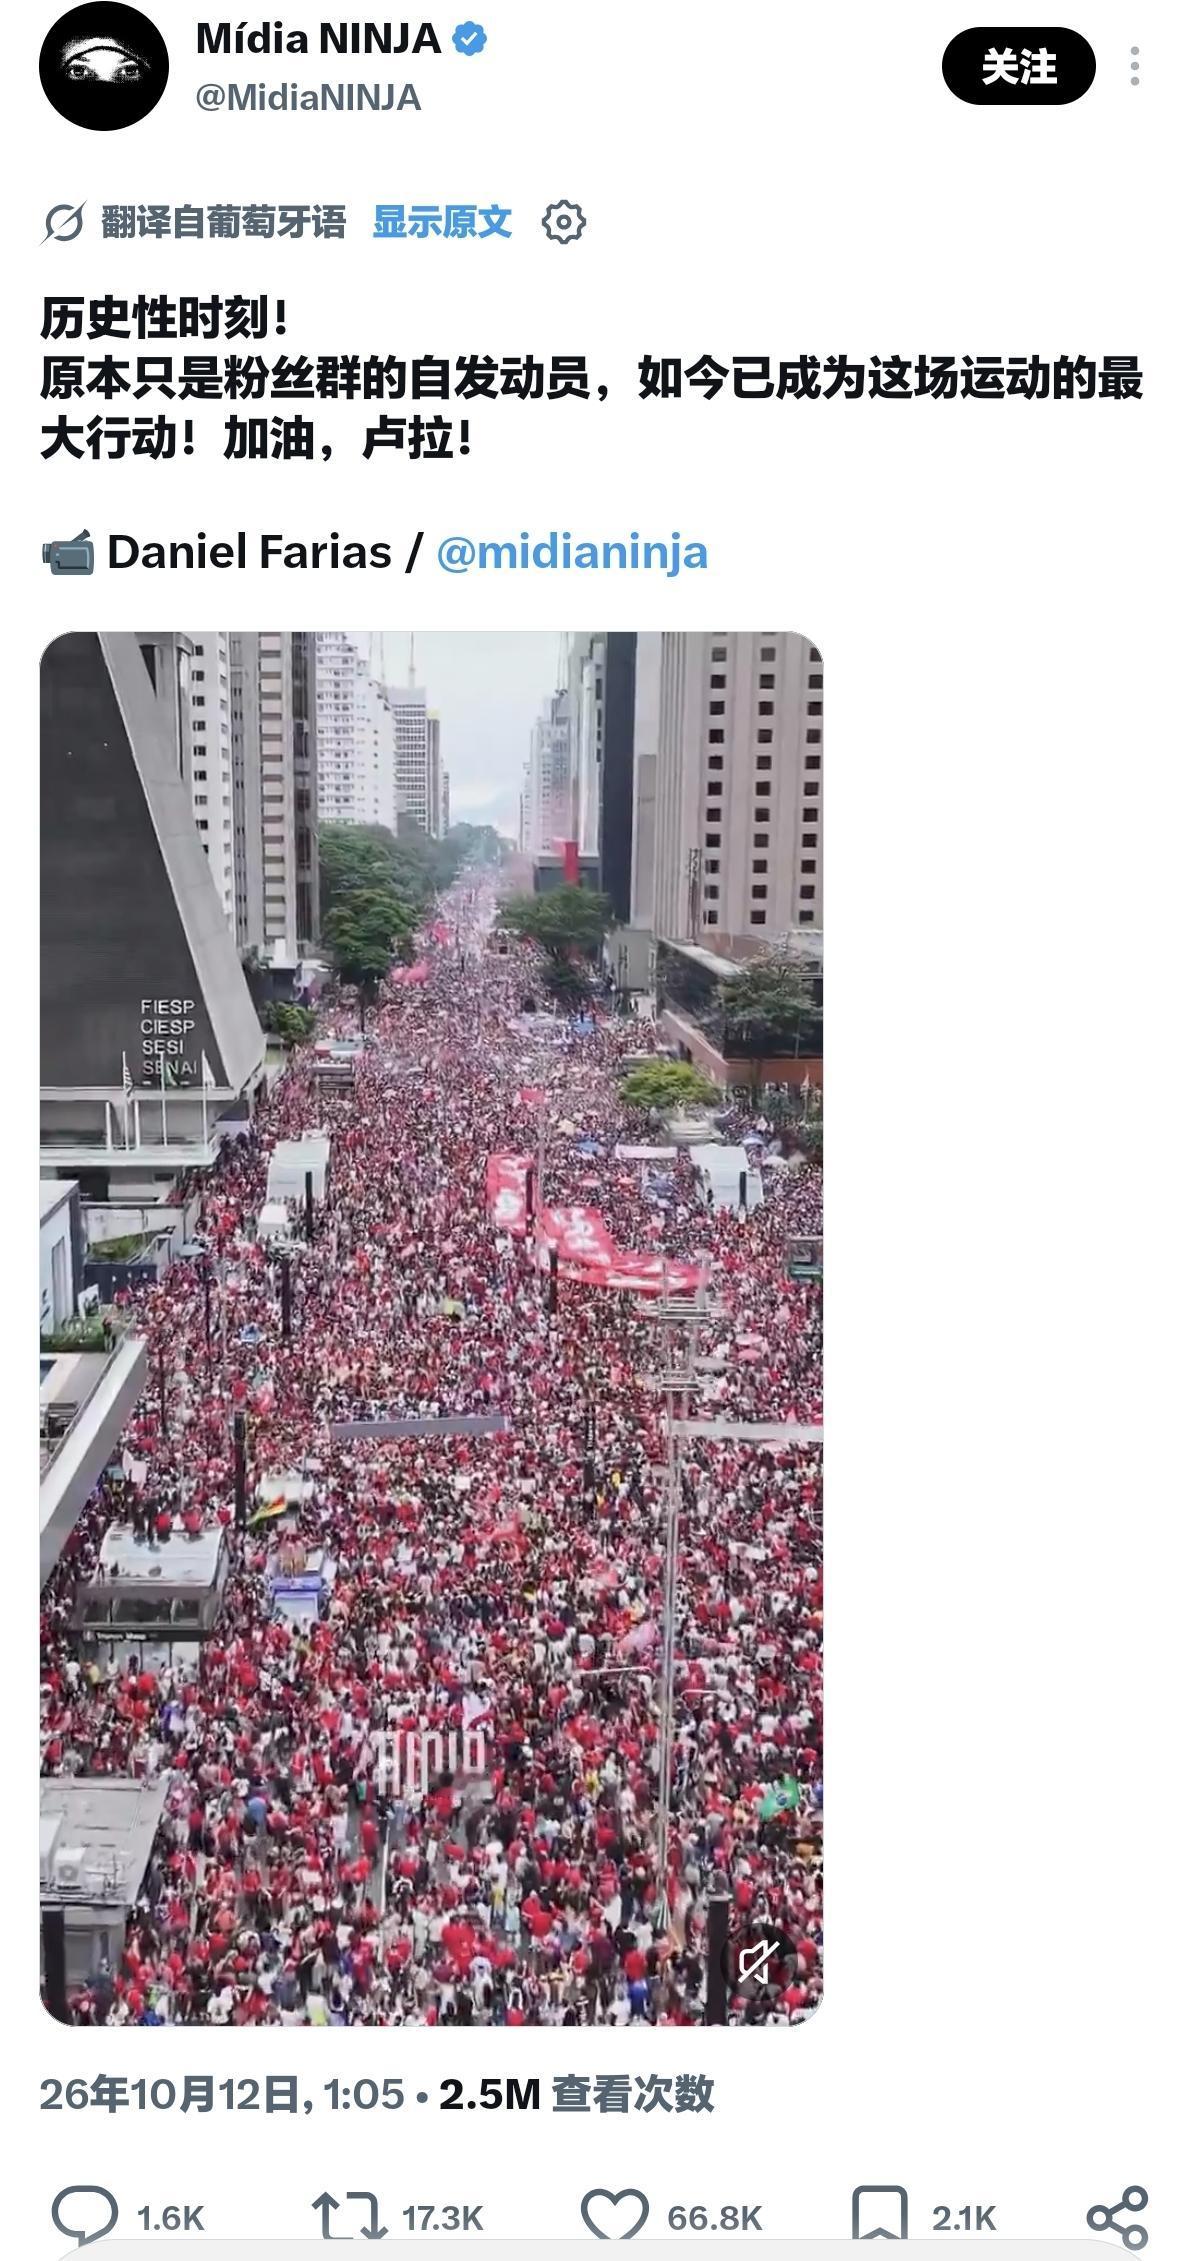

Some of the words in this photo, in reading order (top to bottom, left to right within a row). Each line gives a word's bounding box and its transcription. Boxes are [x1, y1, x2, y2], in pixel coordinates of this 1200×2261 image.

[197, 20, 309, 54] Mídia
[320, 22, 443, 54] NINJA
[981, 46, 1058, 86] 关注
[196, 82, 422, 112] @MidiaNINJA
[101, 203, 347, 240] 翻译自葡萄牙语
[372, 203, 513, 239] 显示原文
[108, 531, 246, 569] Daniel
[260, 531, 392, 569] Farias
[404, 531, 425, 574] /
[437, 531, 708, 578] @midianinja
[140, 999, 196, 1015] FIESP
[140, 1019, 196, 1035] CIESP
[142, 1039, 184, 1055] SESI
[143, 1060, 197, 1075] SENAI
[323, 2078, 405, 2110] 1:05
[439, 2078, 540, 2110] 2.5M
[551, 2073, 715, 2114] 查看次数
[137, 2205, 205, 2231] 1.6K
[402, 2205, 484, 2231] 17.3K
[667, 2205, 763, 2231] 66.8K
[932, 2205, 997, 2231] 2.1K
